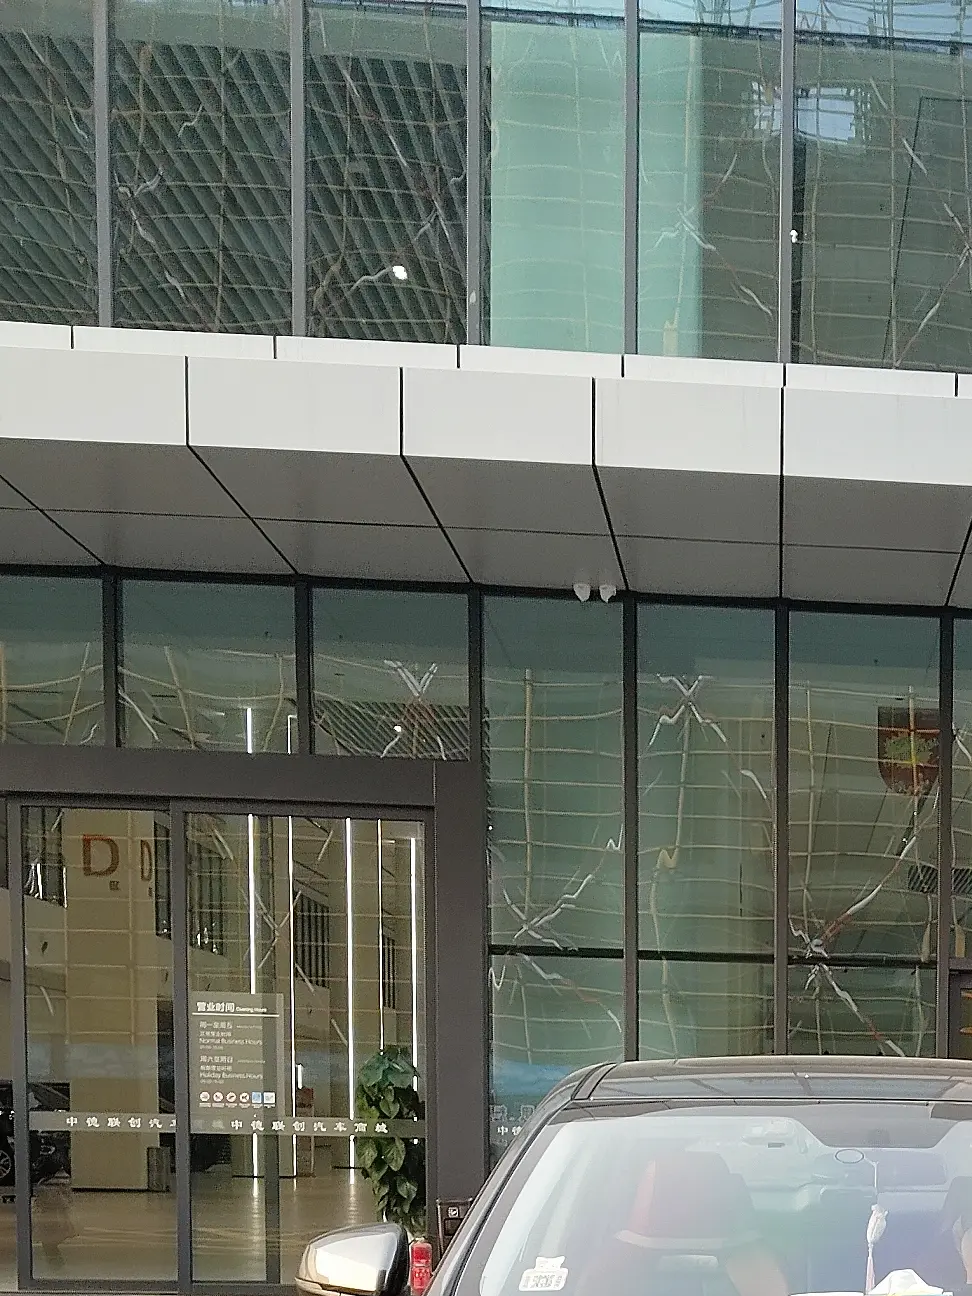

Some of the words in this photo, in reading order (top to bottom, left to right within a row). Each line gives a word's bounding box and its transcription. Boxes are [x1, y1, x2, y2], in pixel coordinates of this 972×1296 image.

[83, 834, 120, 876] D
[197, 1002, 235, 1013] 营业时间
